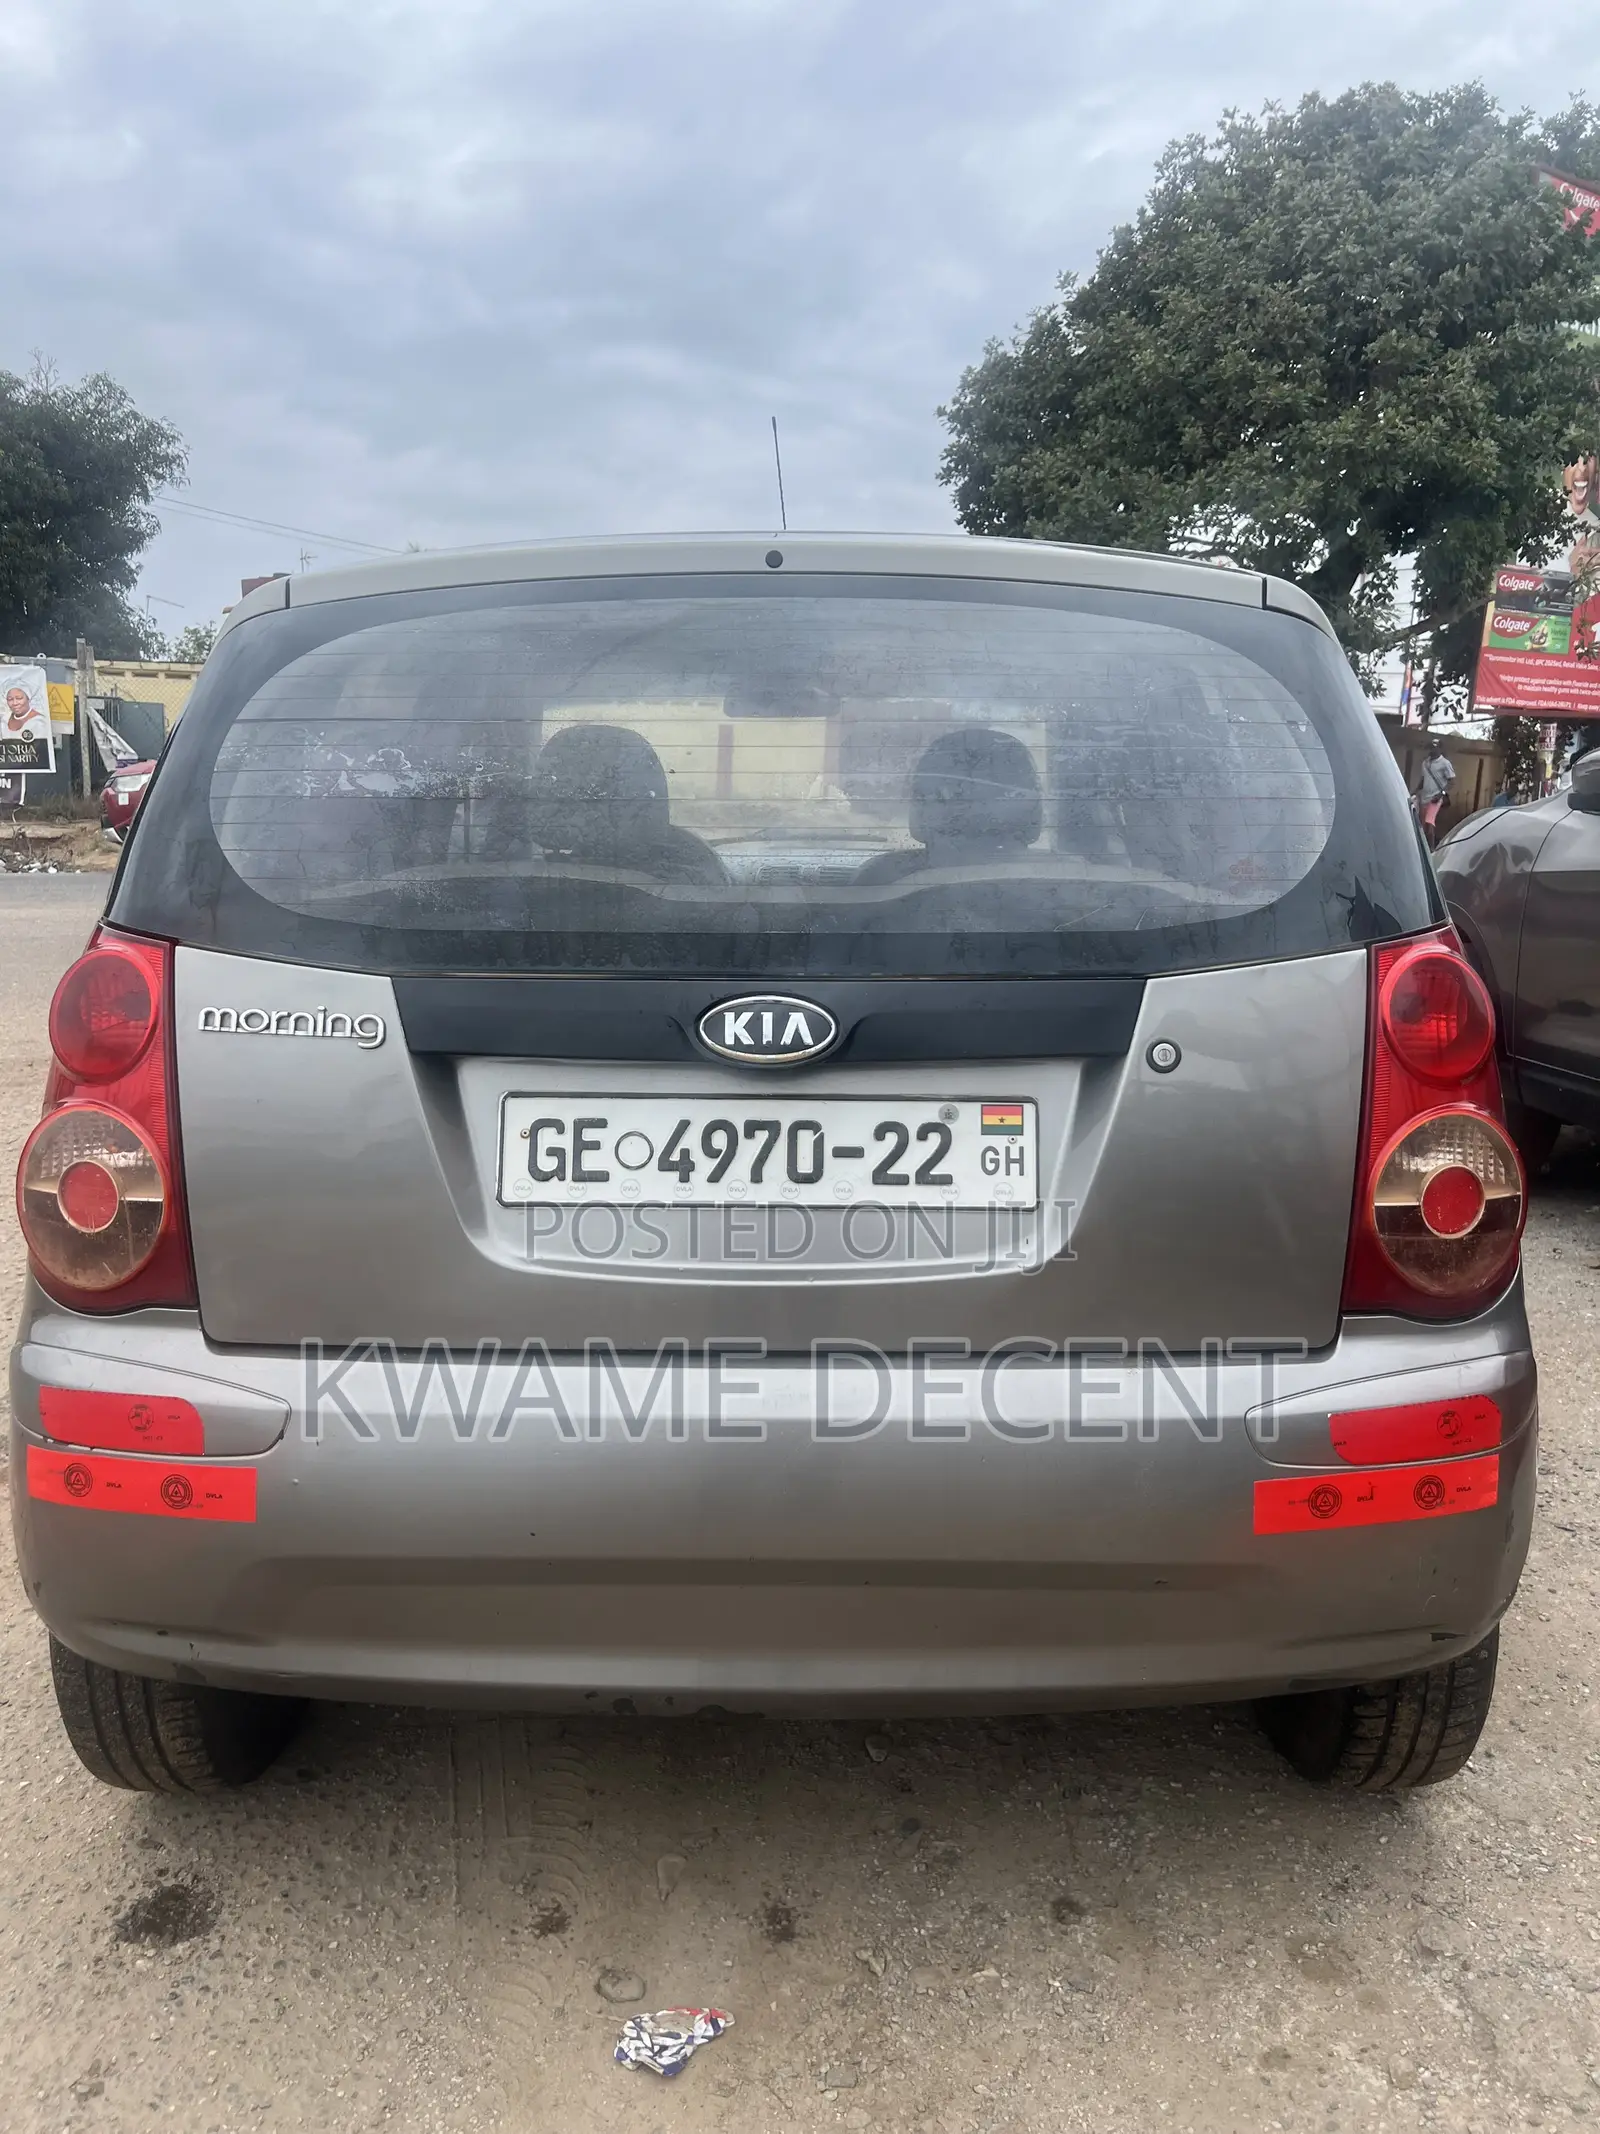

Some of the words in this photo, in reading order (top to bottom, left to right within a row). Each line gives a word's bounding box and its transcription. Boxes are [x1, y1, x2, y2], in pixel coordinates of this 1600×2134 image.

[1499, 575, 1535, 591] Colgate
[1494, 616, 1531, 632] Colgate
[198, 1006, 387, 1050] morning
[723, 1011, 814, 1046] KIA
[528, 1117, 610, 1182] GE
[658, 1118, 953, 1186] 4970-22
[980, 1145, 1025, 1177] GH
